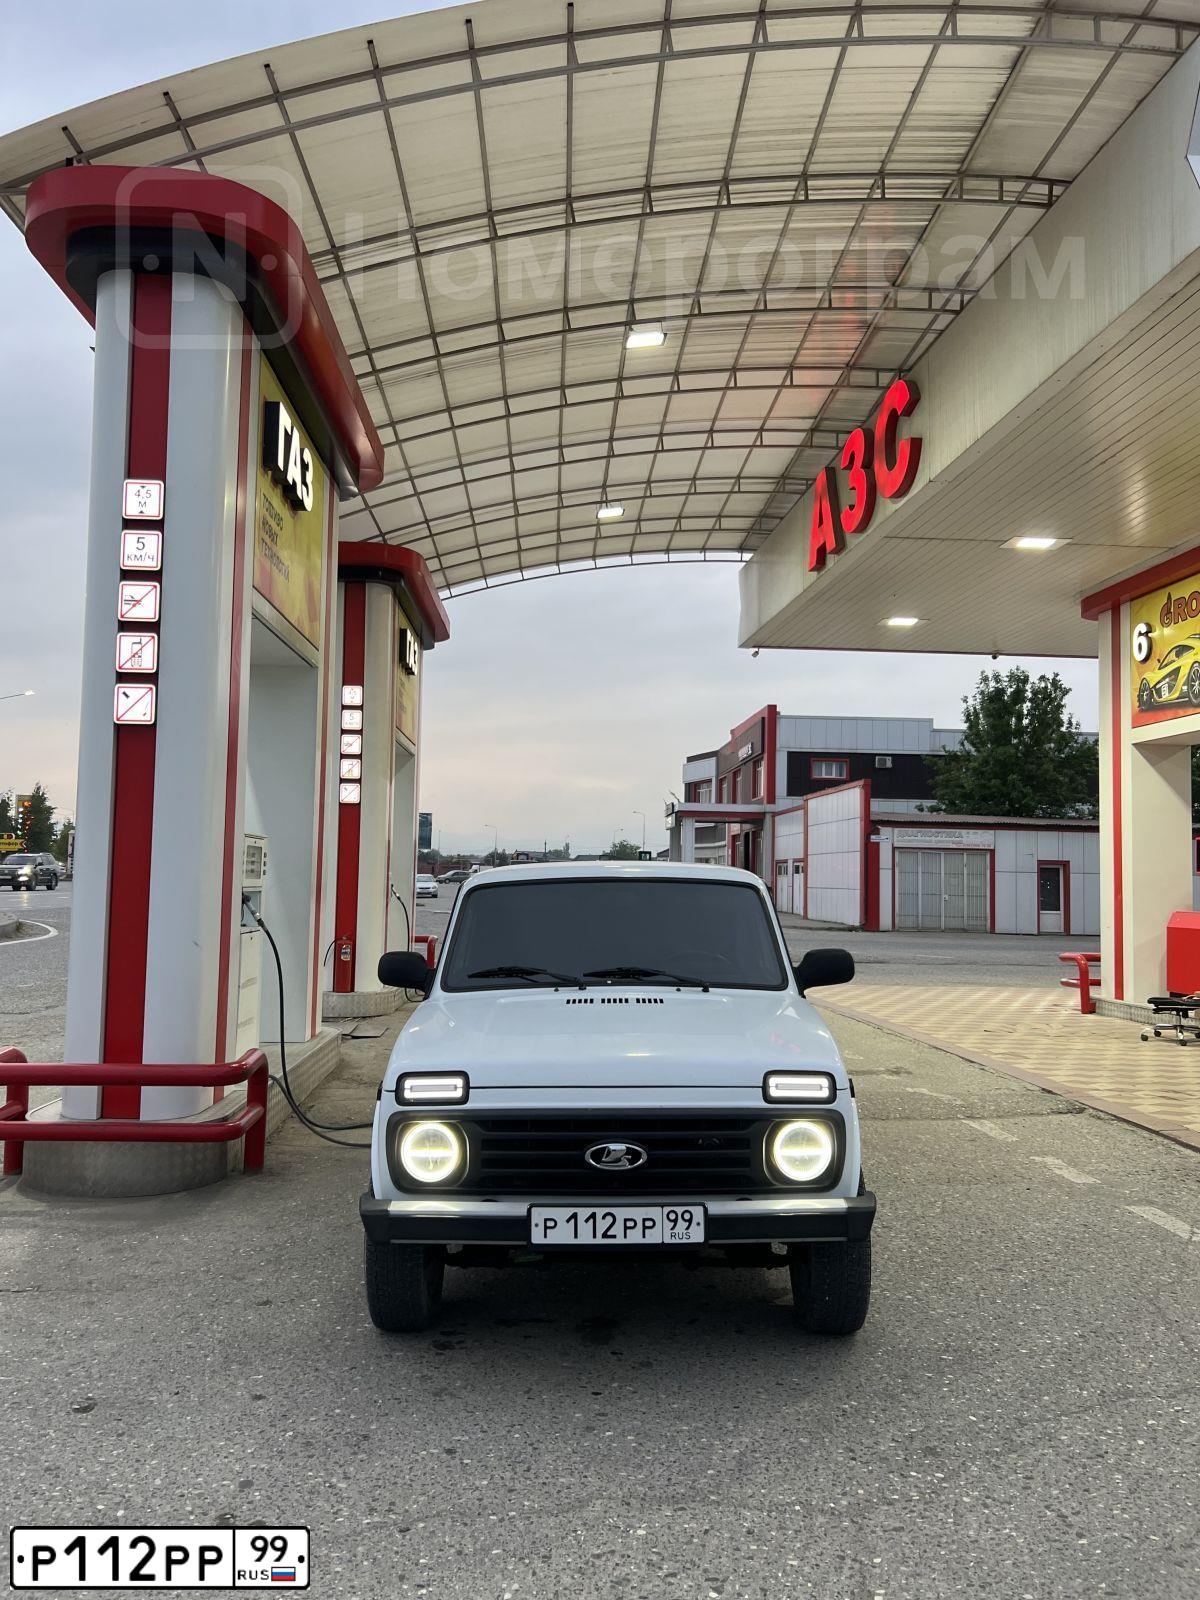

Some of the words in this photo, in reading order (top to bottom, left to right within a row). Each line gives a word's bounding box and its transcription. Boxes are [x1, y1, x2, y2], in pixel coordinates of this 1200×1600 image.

[268, 401, 314, 512] ГАЗ
[808, 379, 921, 572] АЗС
[136, 536, 146, 551] 5
[1133, 623, 1151, 664] 6
[666, 1210, 693, 1230] 99
[670, 1232, 691, 1240] RUS
